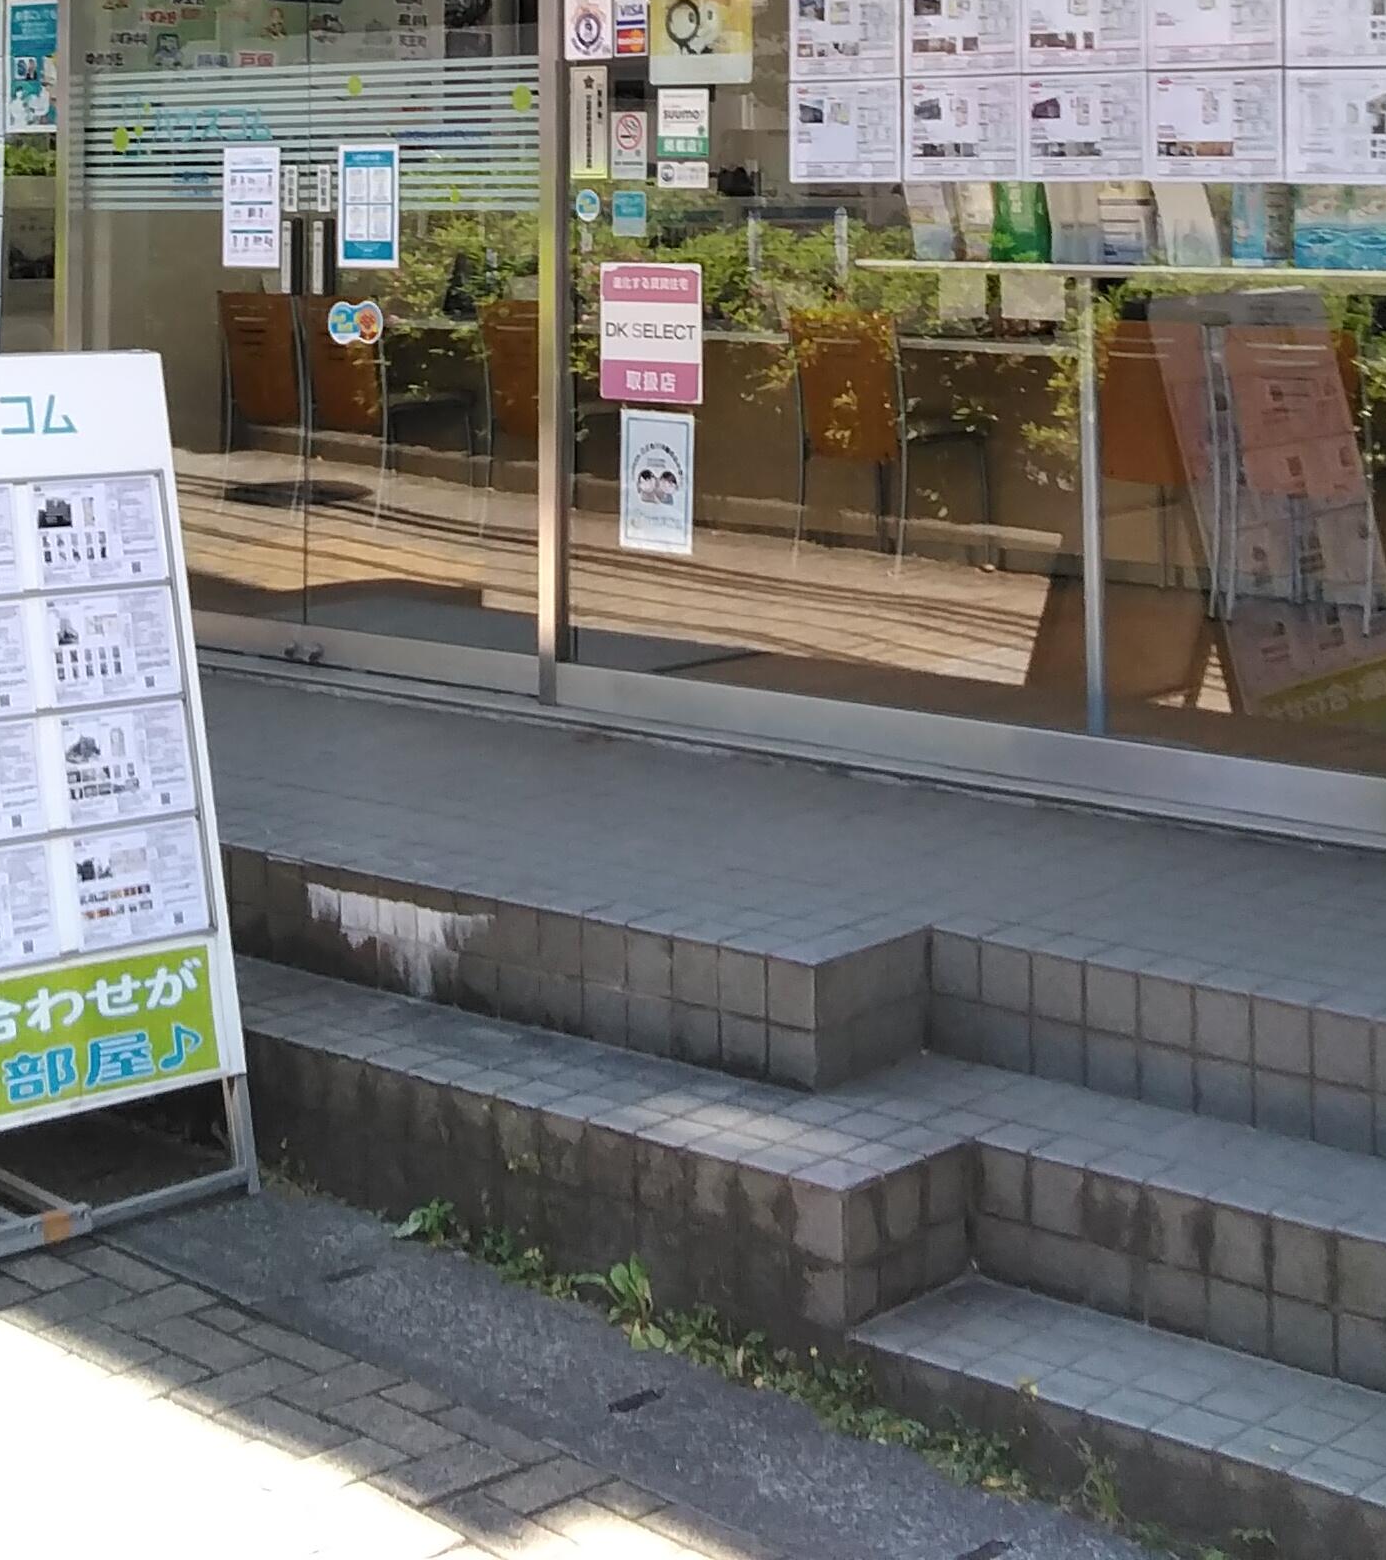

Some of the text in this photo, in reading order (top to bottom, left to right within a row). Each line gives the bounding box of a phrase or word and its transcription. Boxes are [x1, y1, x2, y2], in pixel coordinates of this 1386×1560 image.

[619, 3, 645, 17] VISA
[604, 321, 697, 341] DK SELECT
[625, 369, 678, 393] 取扱店
